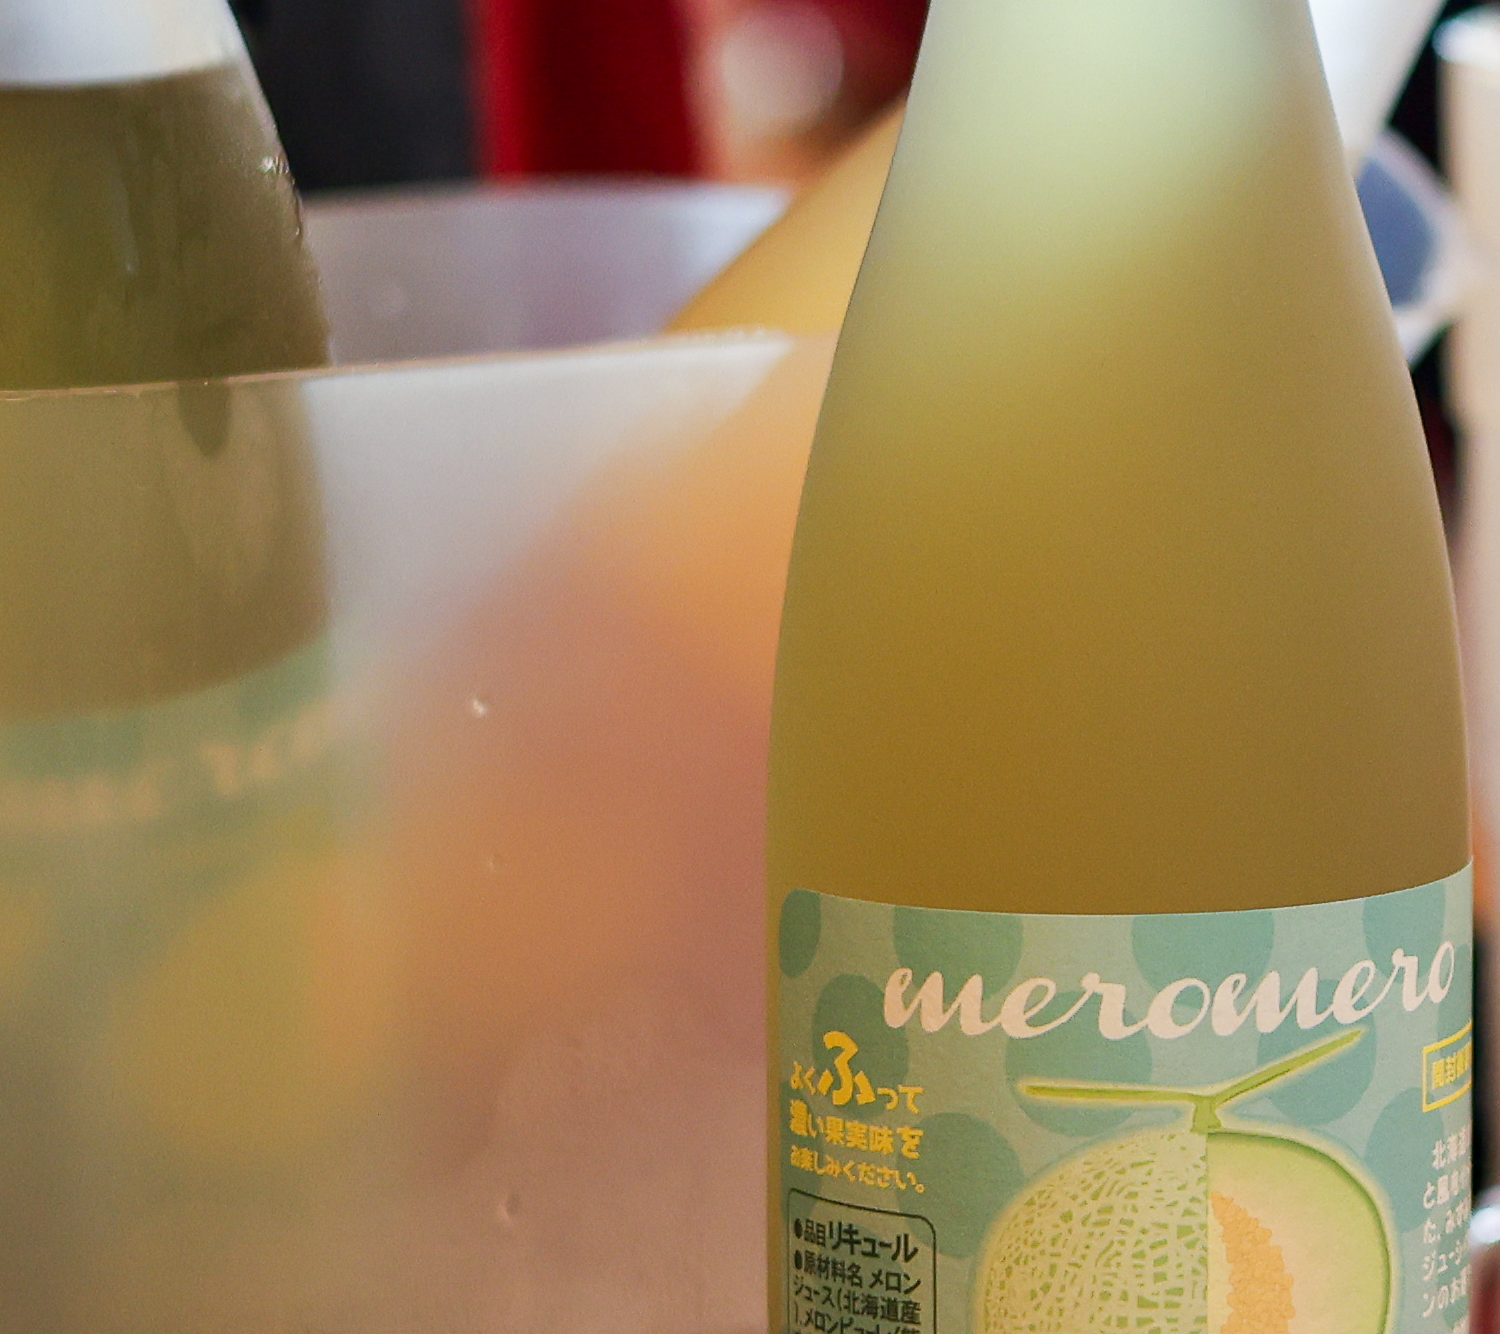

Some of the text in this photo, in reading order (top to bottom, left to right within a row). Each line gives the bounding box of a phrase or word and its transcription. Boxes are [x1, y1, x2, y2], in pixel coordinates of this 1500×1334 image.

[883, 940, 1455, 1040] meromero
[790, 1030, 925, 1114] よくふって
[869, 1269, 922, 1295] メロン
